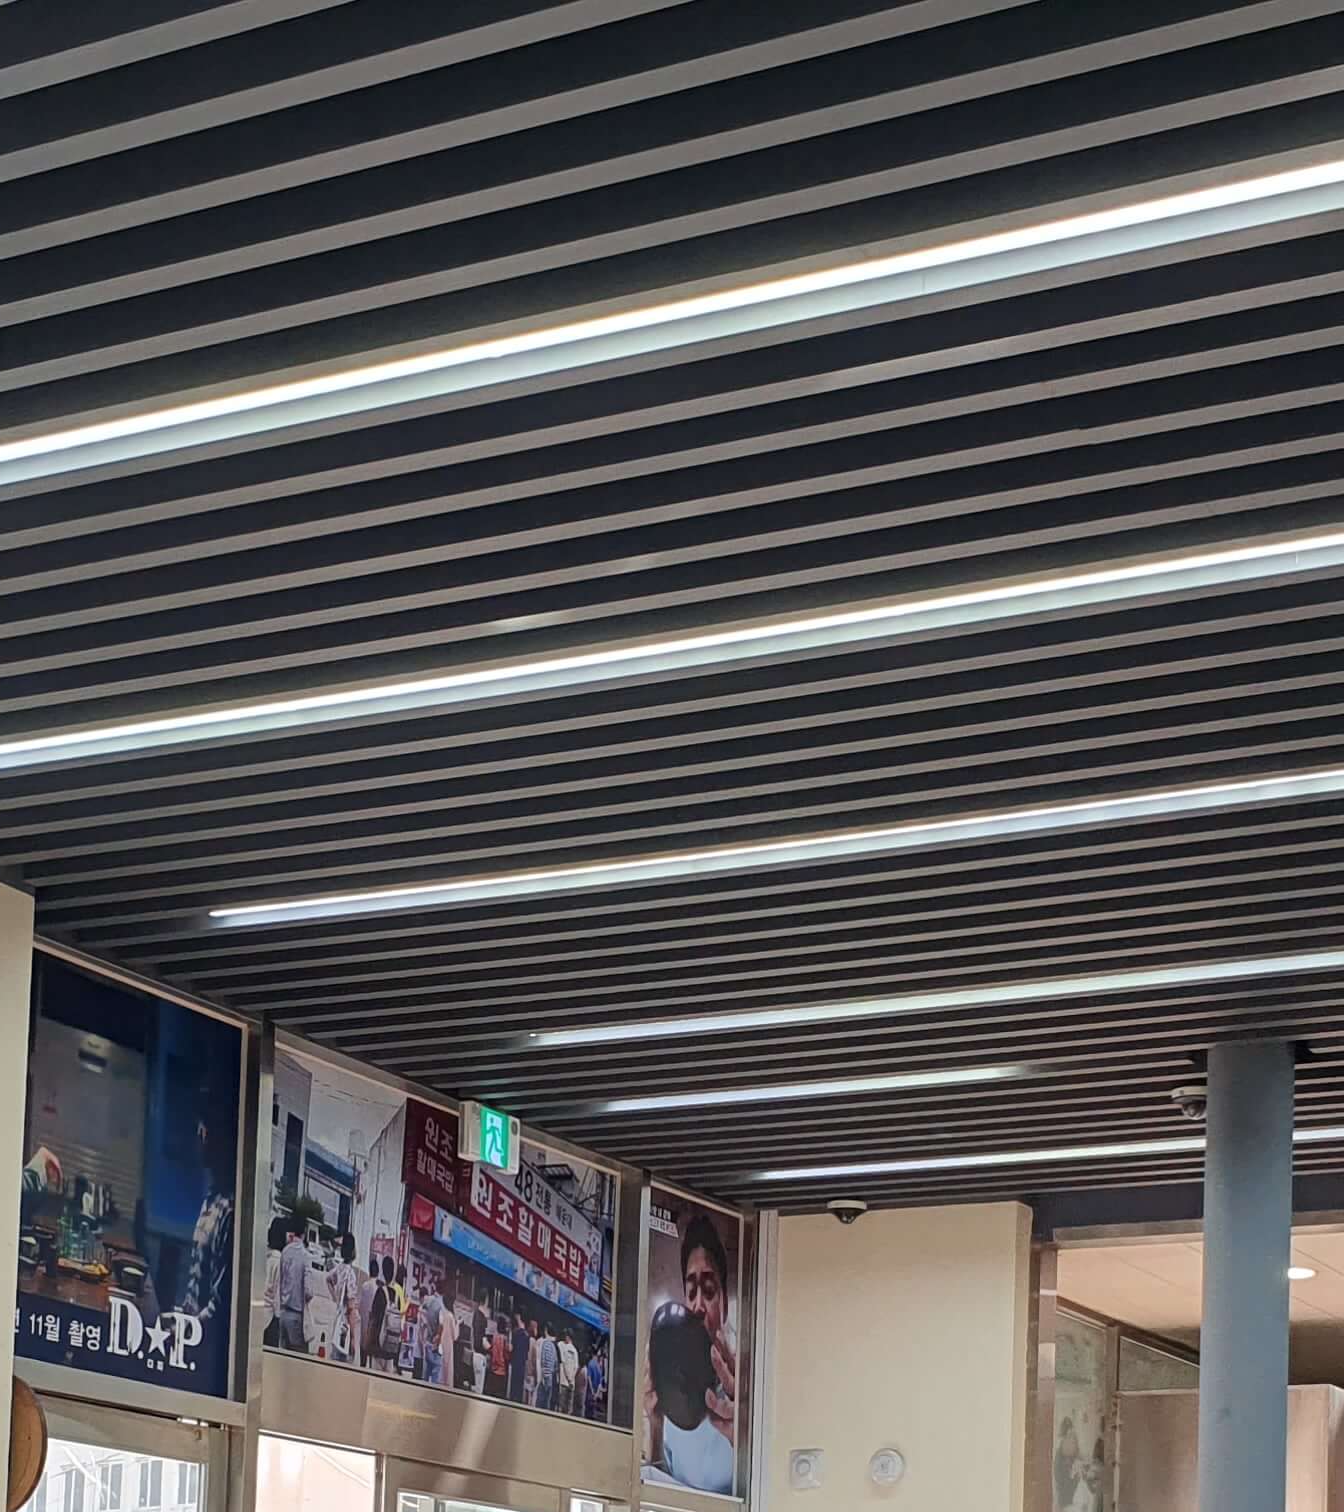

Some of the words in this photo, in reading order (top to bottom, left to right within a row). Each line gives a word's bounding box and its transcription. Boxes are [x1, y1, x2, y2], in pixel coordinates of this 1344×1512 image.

[471, 1172, 583, 1284] 원조할매국밥
[29, 1312, 60, 1343] 11월
[68, 1319, 102, 1352] 촬영
